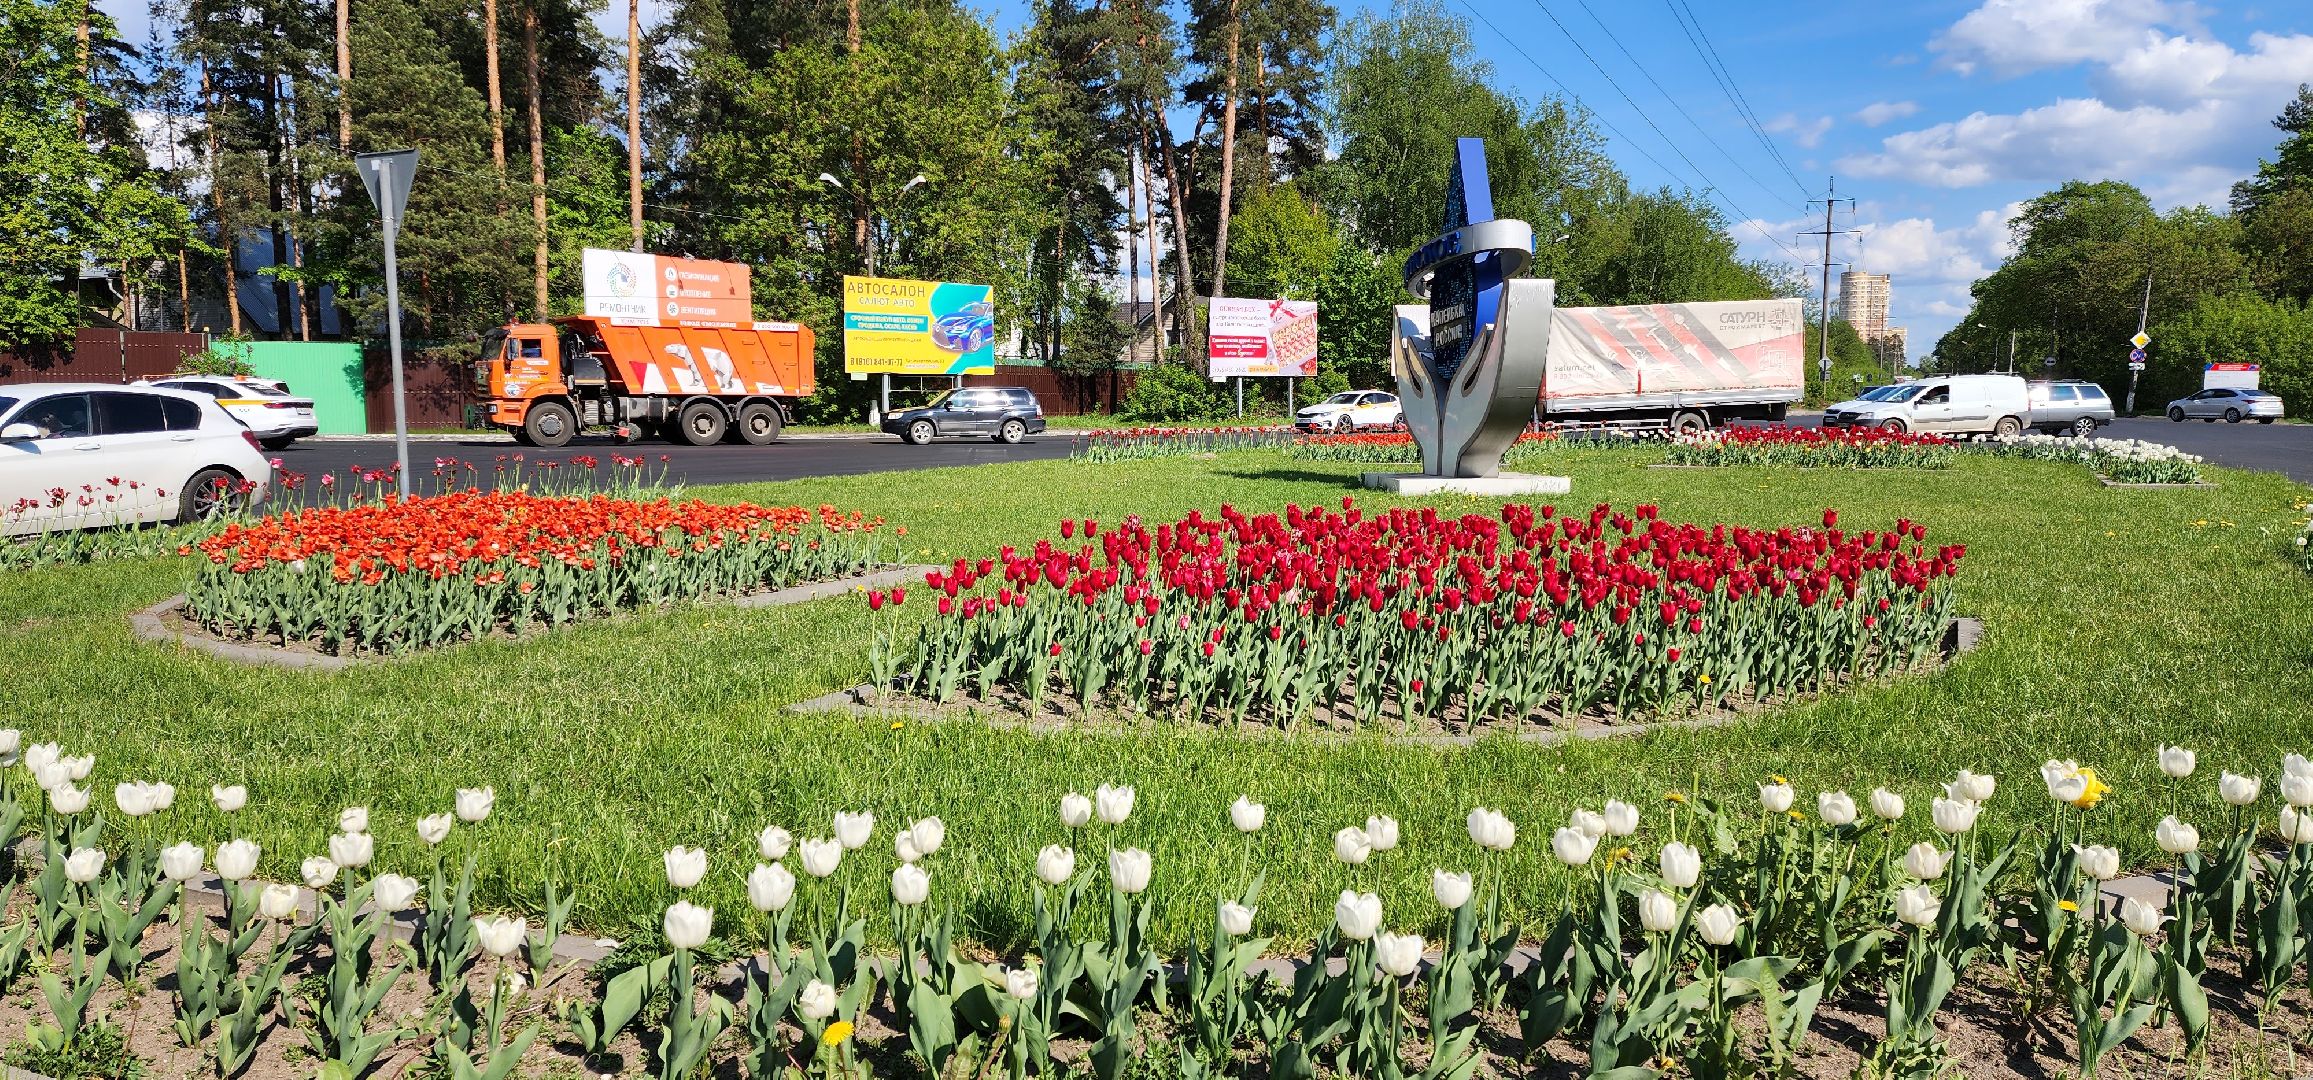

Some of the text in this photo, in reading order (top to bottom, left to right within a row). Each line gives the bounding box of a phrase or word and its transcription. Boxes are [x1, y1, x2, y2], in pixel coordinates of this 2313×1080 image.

[847, 282, 925, 297] АВТОСАЛОН
[599, 302, 646, 314] РЕМОНТНИК
[859, 296, 915, 308] САЛЮТ АВТО
[1719, 311, 1766, 324] САТУРН
